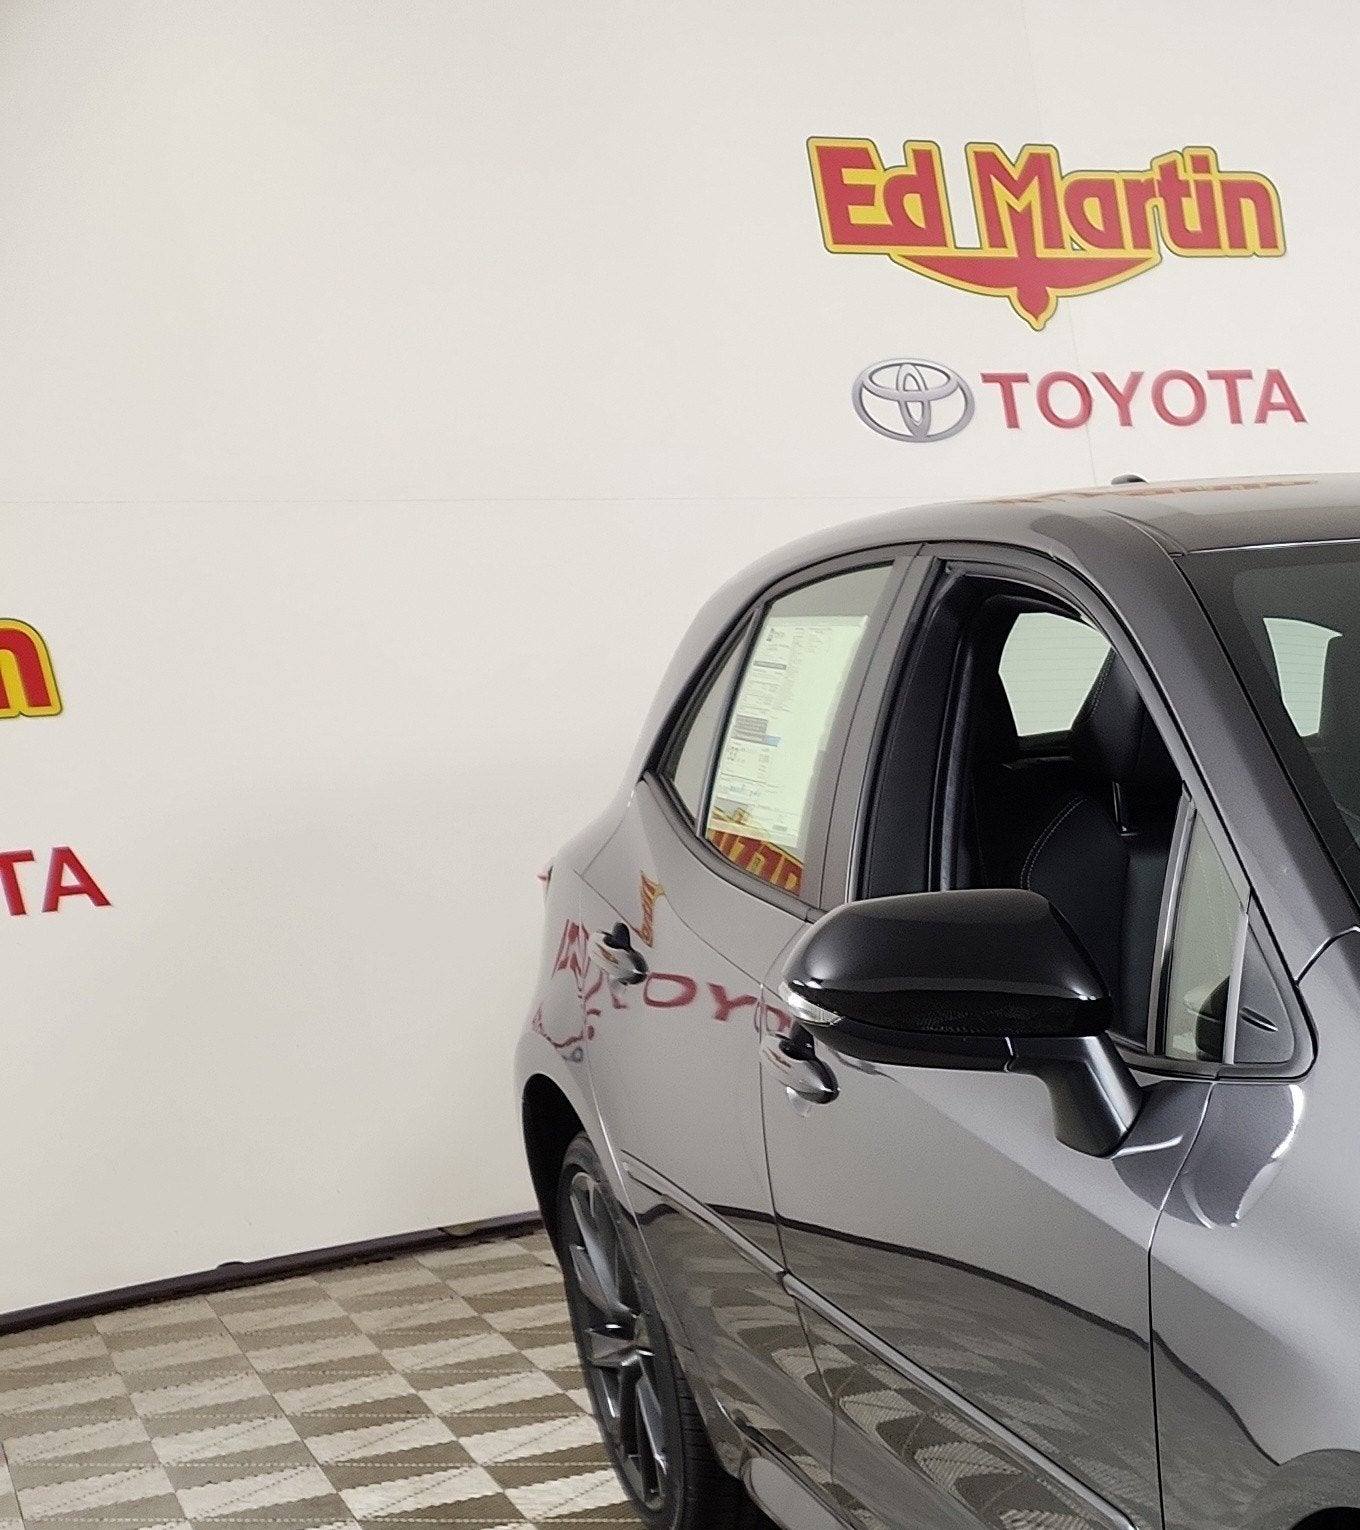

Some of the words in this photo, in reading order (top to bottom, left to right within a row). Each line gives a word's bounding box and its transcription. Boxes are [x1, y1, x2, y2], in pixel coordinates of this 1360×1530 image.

[807, 137, 954, 253] Ed
[965, 142, 1286, 257] Martin
[981, 369, 1308, 429] TOYOTA
